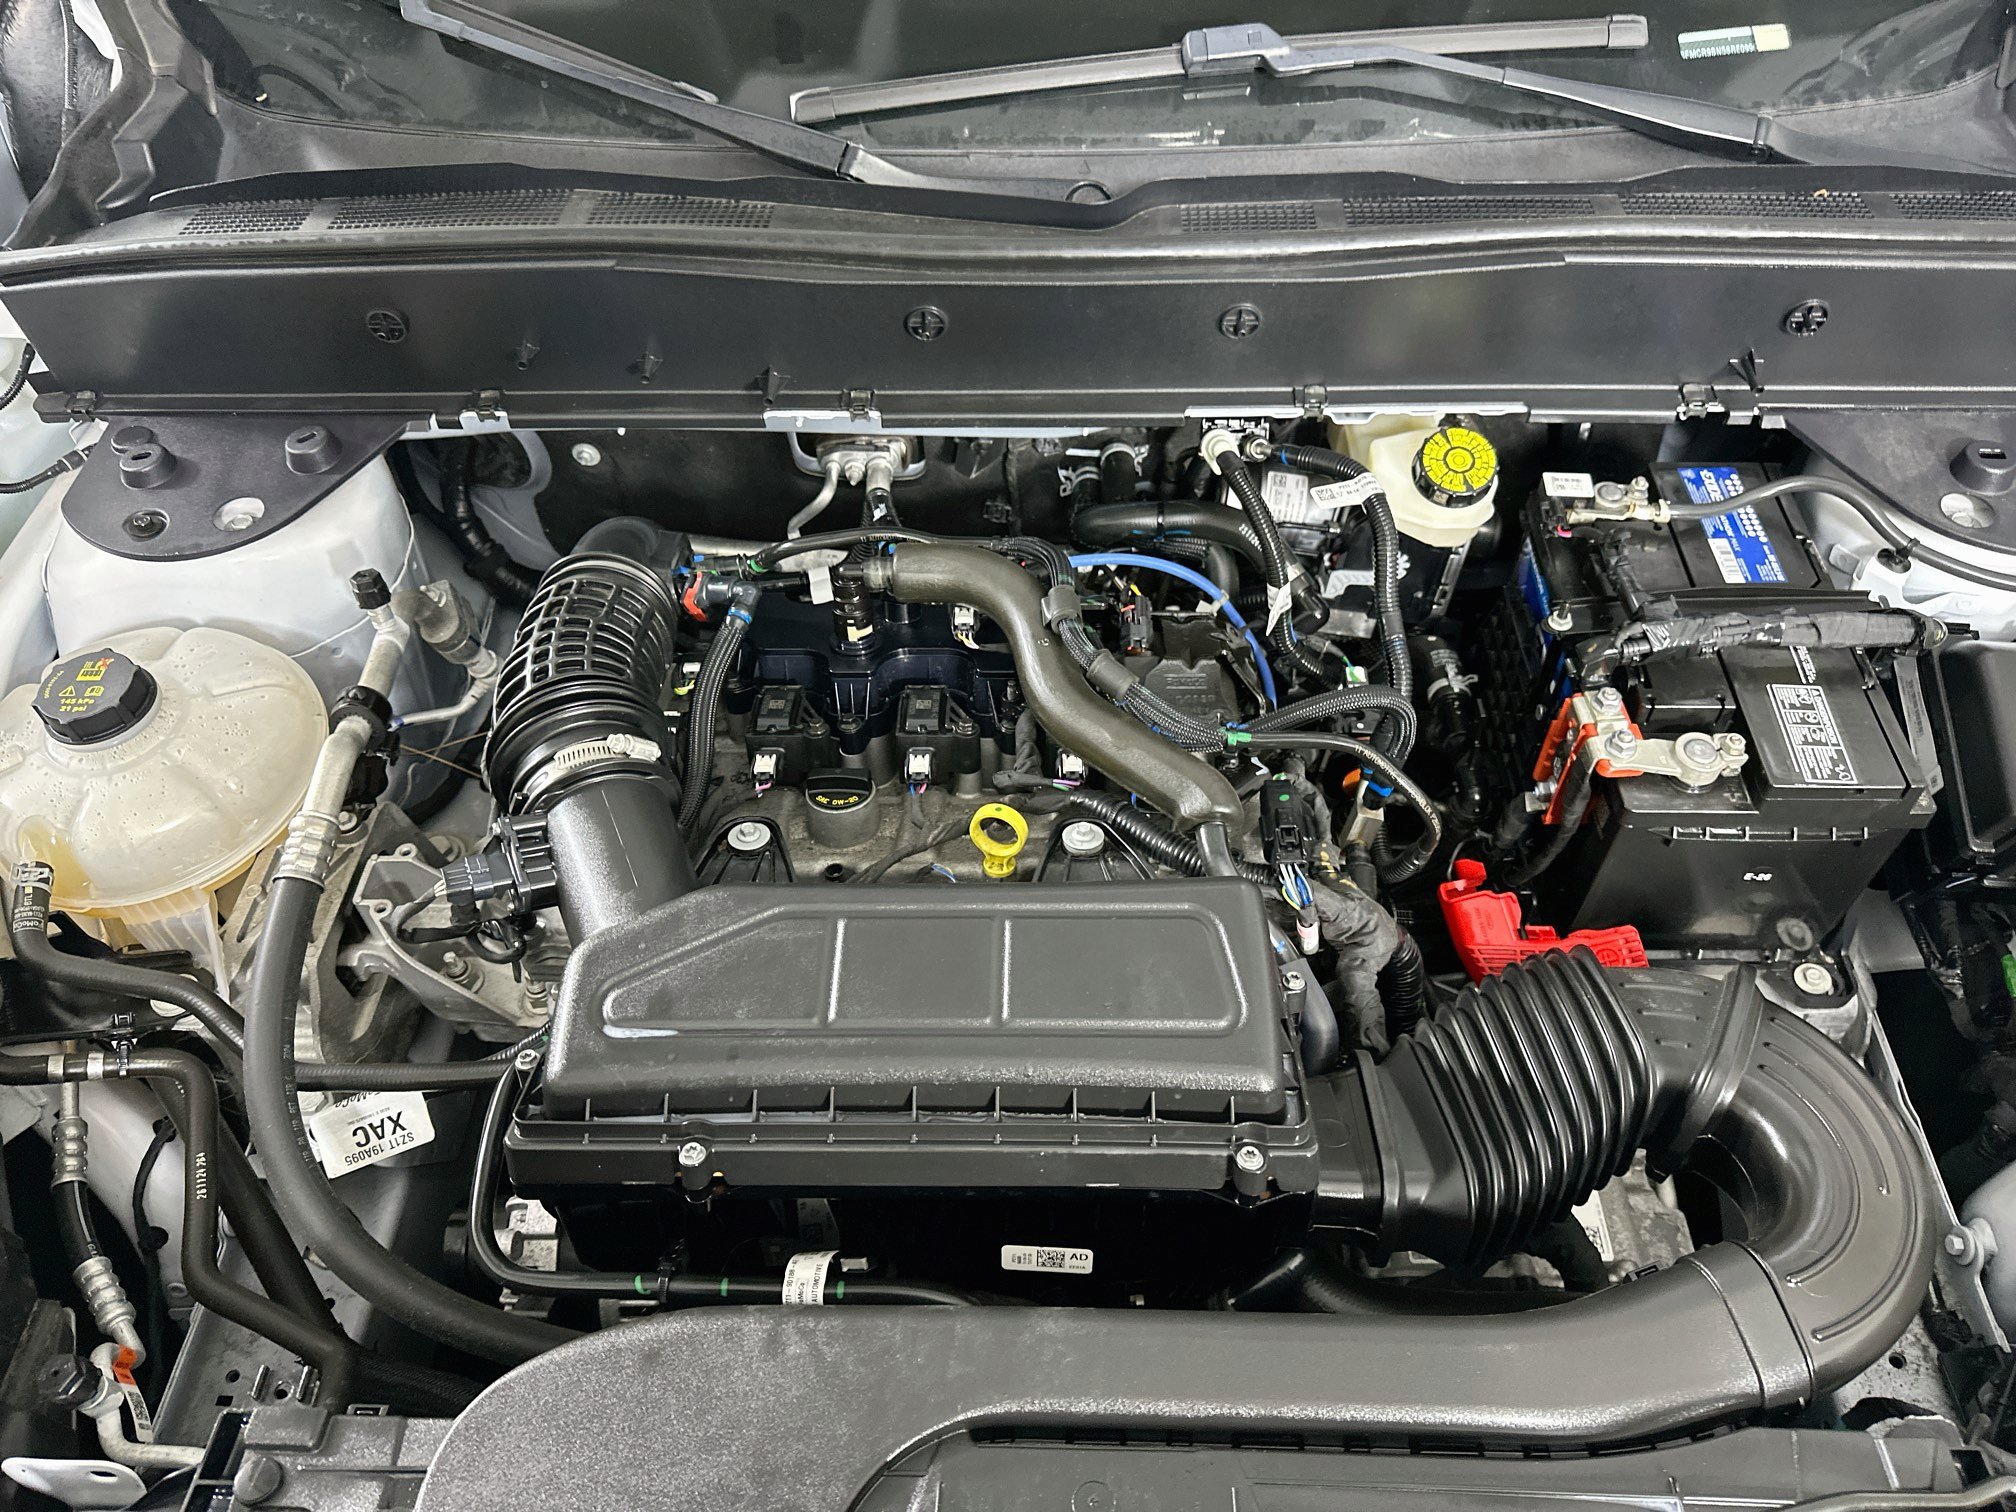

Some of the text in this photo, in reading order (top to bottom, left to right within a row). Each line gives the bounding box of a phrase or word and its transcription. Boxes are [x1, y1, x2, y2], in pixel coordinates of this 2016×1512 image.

[815, 795, 830, 804] SAE
[352, 1110, 408, 1148] XAC
[344, 1144, 385, 1167] 19A095
[1069, 1253, 1089, 1262] AD
[811, 1263, 824, 1303] AUTOMOTIVE
